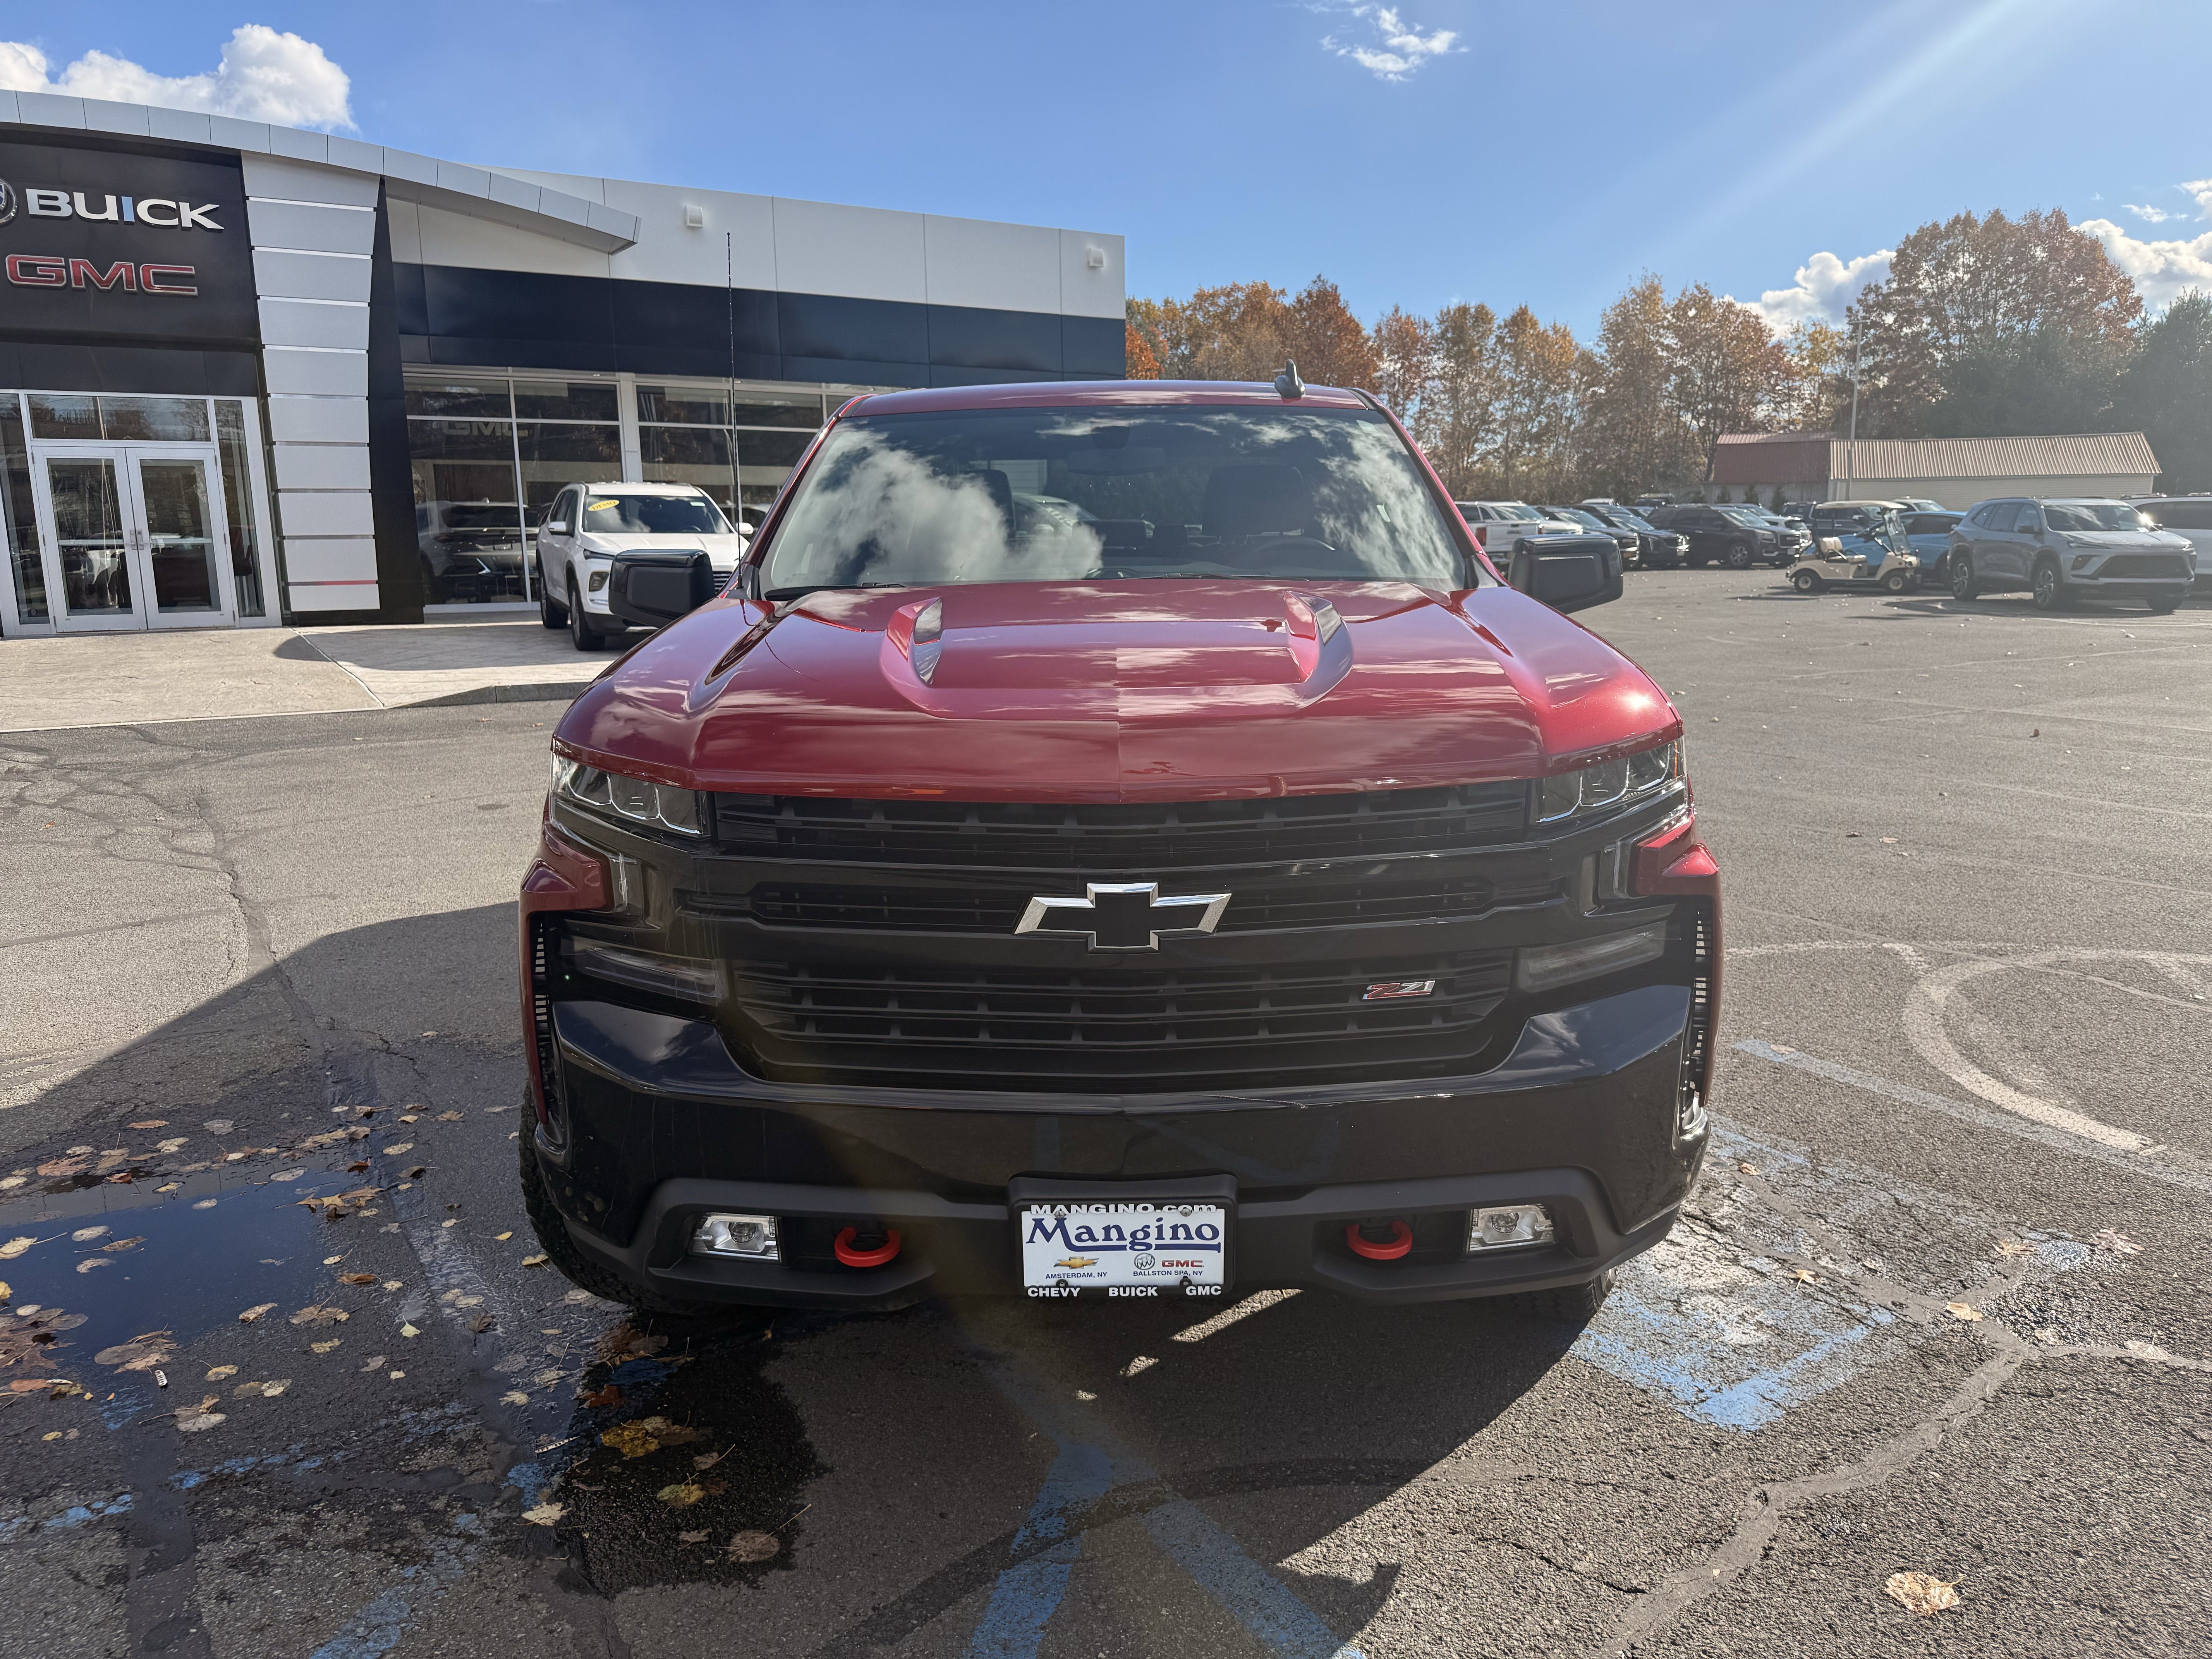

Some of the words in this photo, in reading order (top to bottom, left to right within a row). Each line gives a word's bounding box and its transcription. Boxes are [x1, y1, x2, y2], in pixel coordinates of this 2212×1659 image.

[25, 188, 225, 230] BUICK
[5, 254, 198, 296] GMC
[1362, 980, 1436, 1000] Z71
[1025, 1217, 1220, 1252] Mangino
[1027, 1287, 1080, 1297] CHEVY
[1109, 1286, 1158, 1297] BUICK
[1185, 1285, 1221, 1296] GMC
